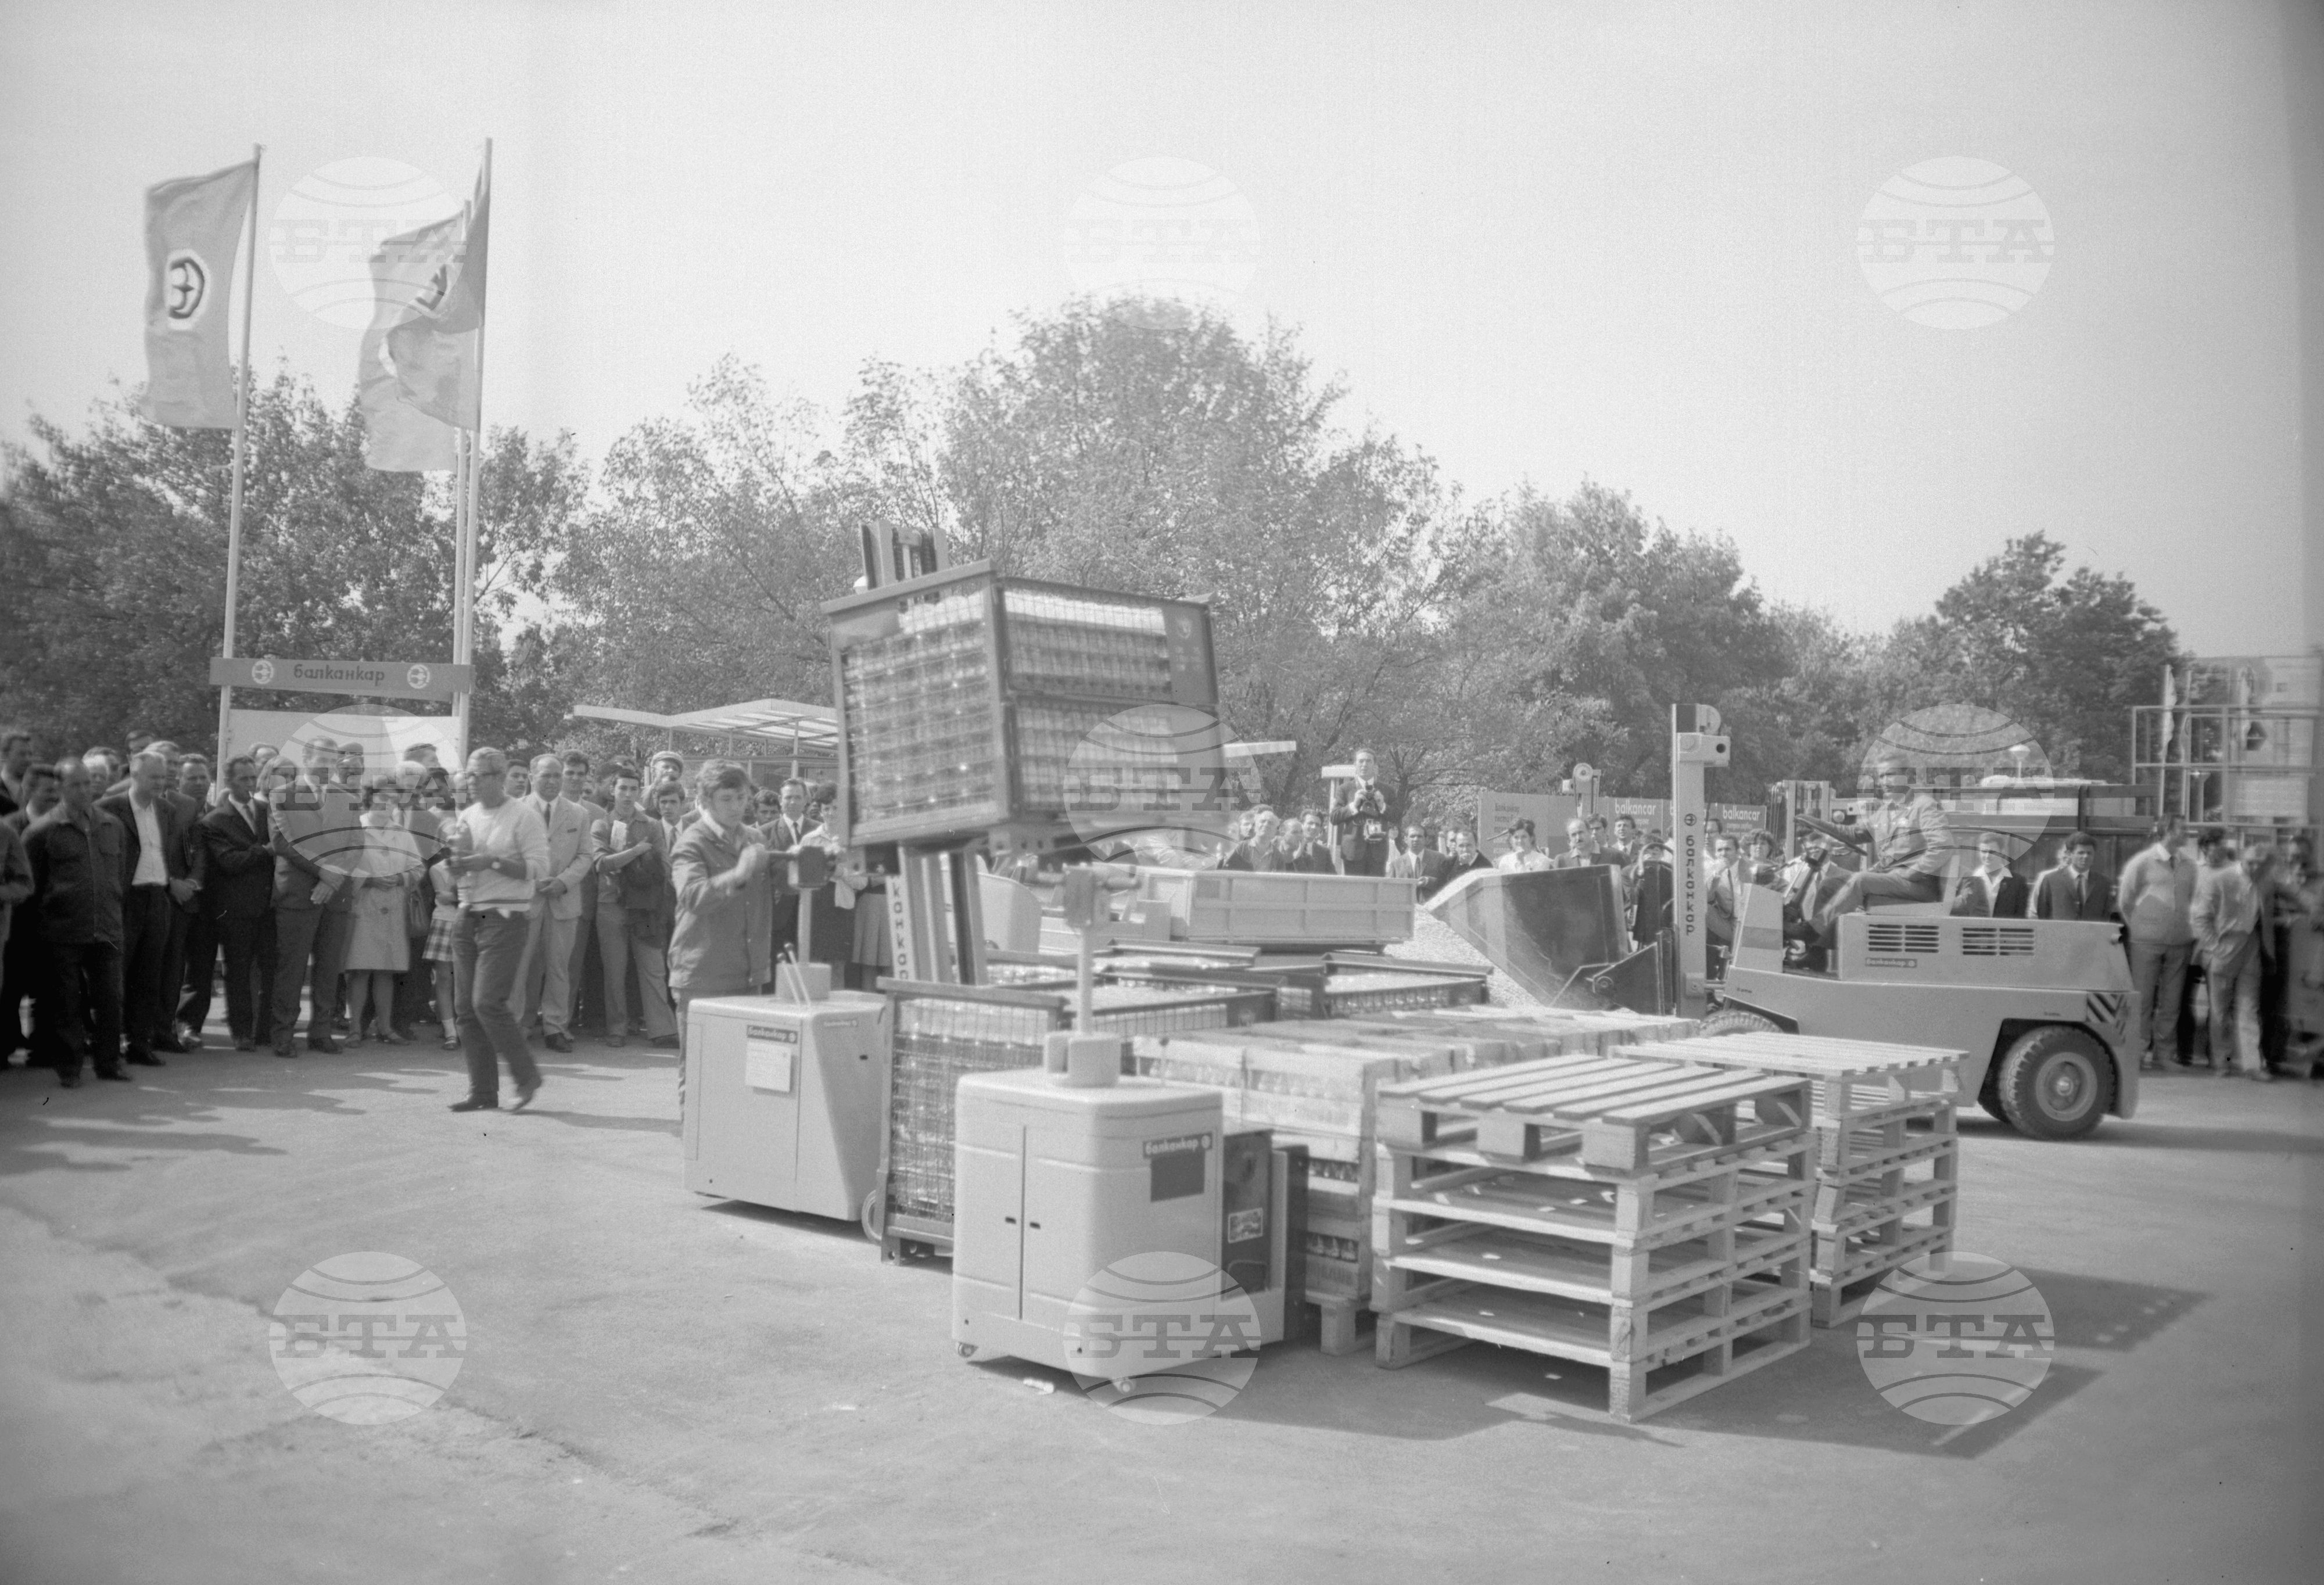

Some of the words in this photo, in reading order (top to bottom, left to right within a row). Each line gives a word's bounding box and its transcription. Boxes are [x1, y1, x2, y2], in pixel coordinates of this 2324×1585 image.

[293, 664, 385, 686] балканкар
[1615, 798, 1656, 815] balkancar
[1723, 804, 1760, 821] balkancar
[1685, 834, 1695, 936] балканкар
